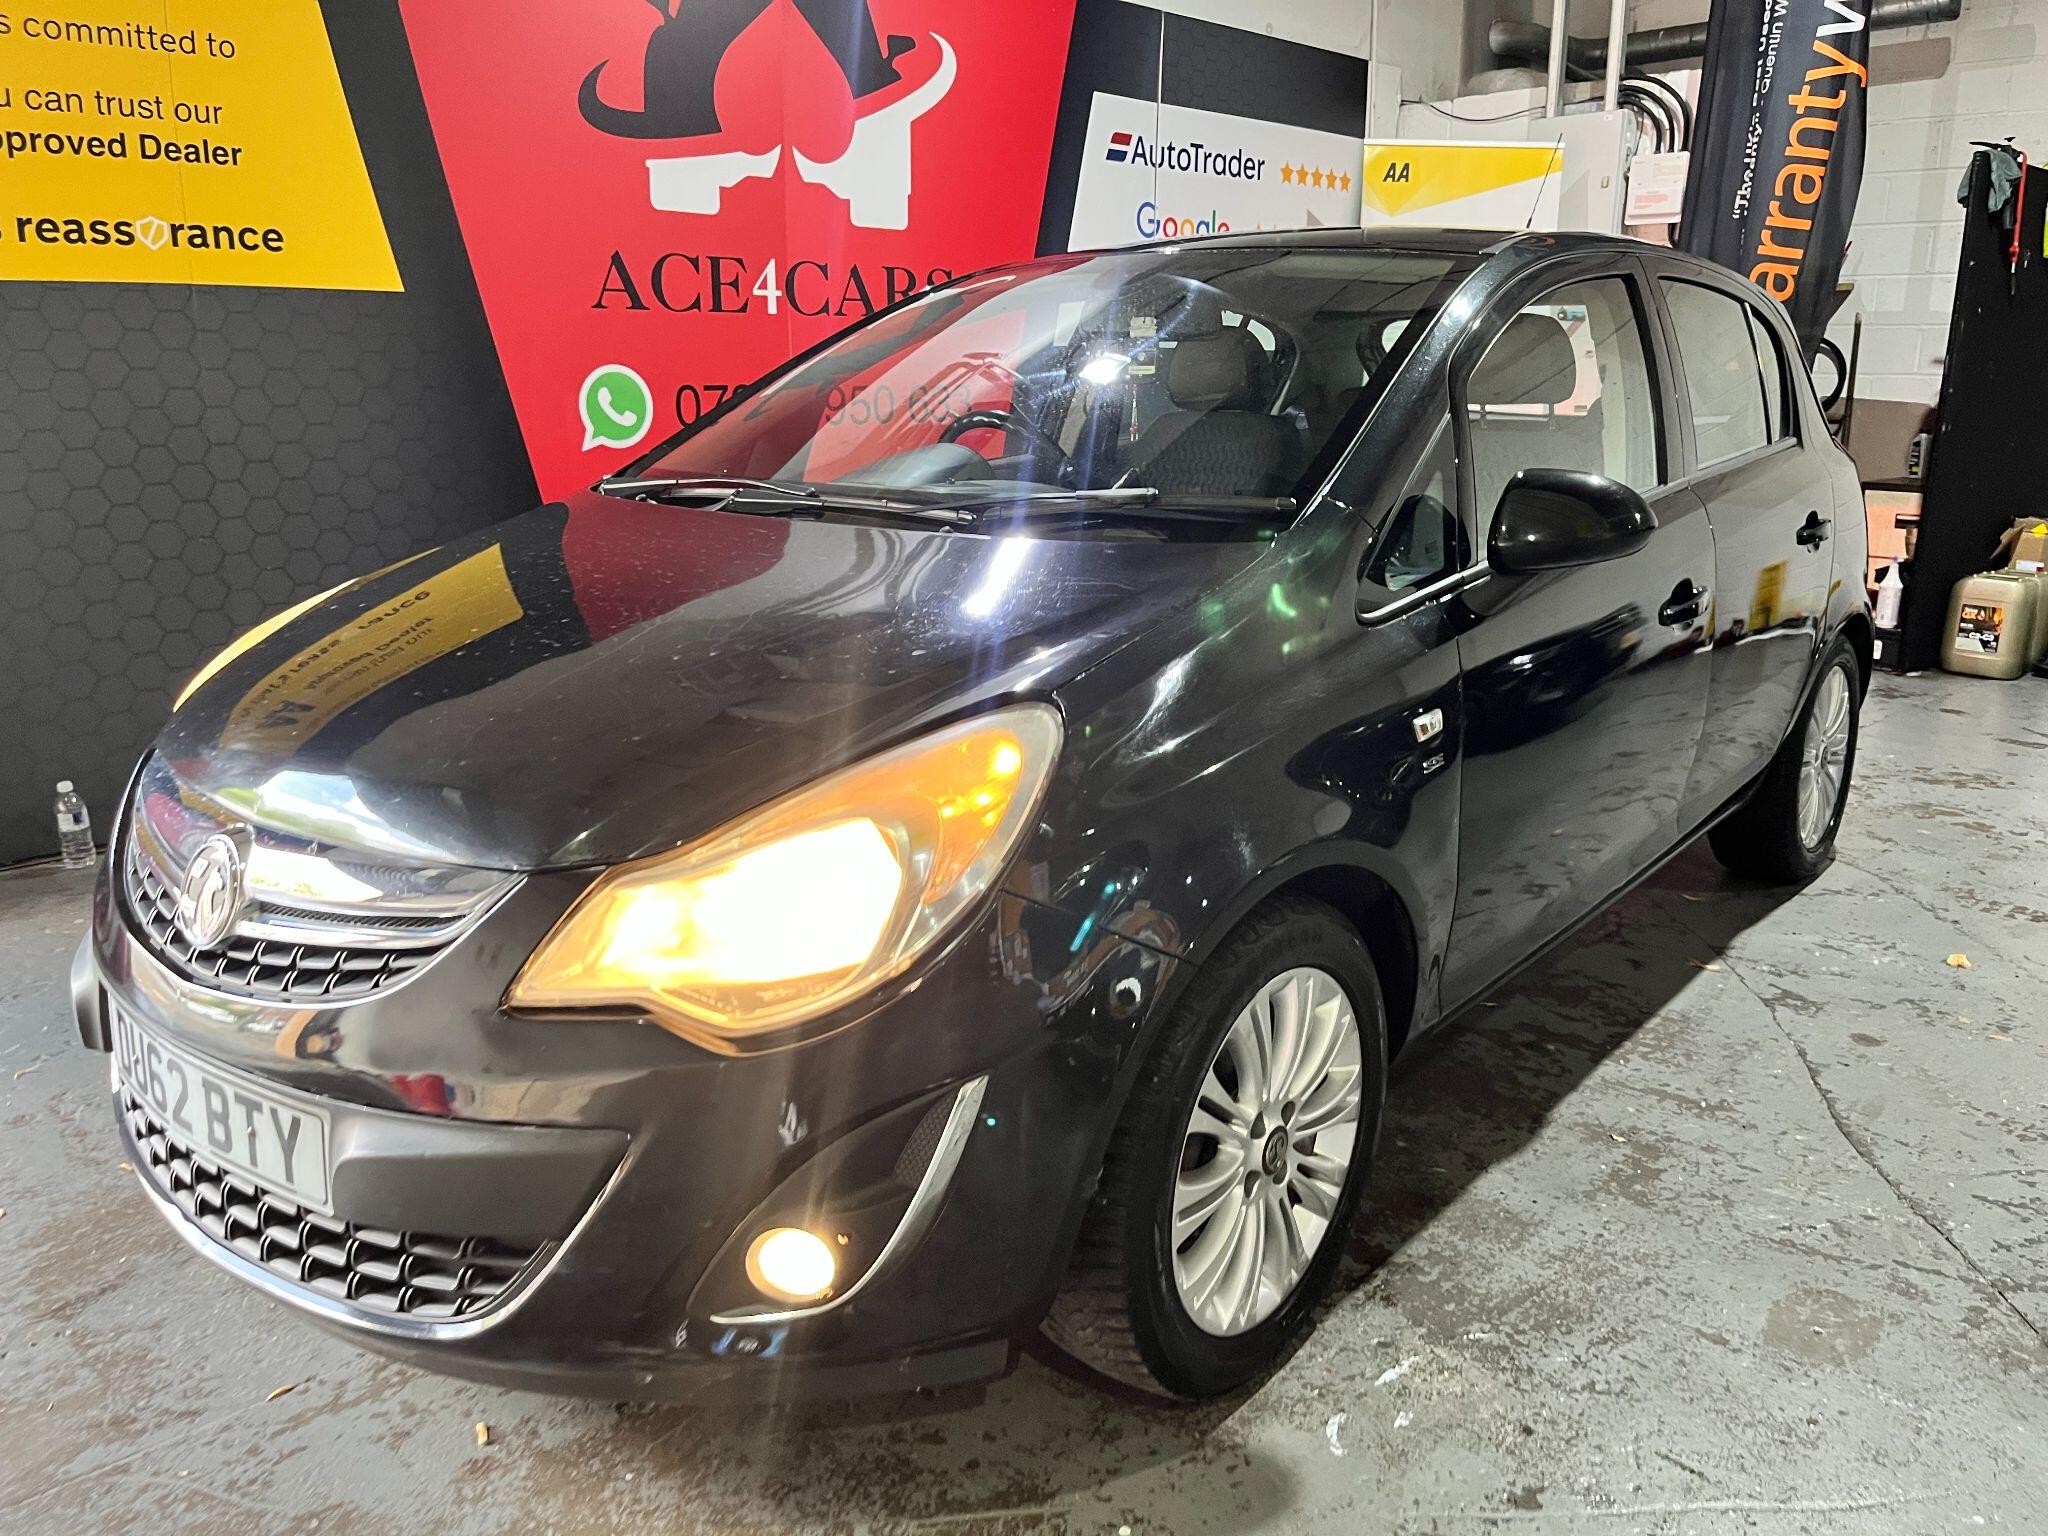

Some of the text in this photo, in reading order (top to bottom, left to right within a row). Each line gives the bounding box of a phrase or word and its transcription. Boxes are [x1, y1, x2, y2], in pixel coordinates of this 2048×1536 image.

[23, 17, 197, 55] committed
[206, 32, 236, 59] to
[1761, 20, 1784, 94] Quentin
[25, 88, 84, 114] can
[95, 90, 164, 120] trust
[174, 101, 223, 125] our
[0, 130, 243, 166] pproved Dealer
[1131, 136, 1265, 181] AutoTrader
[1383, 162, 1411, 183] AA
[202, 1076, 301, 1185] BTY
